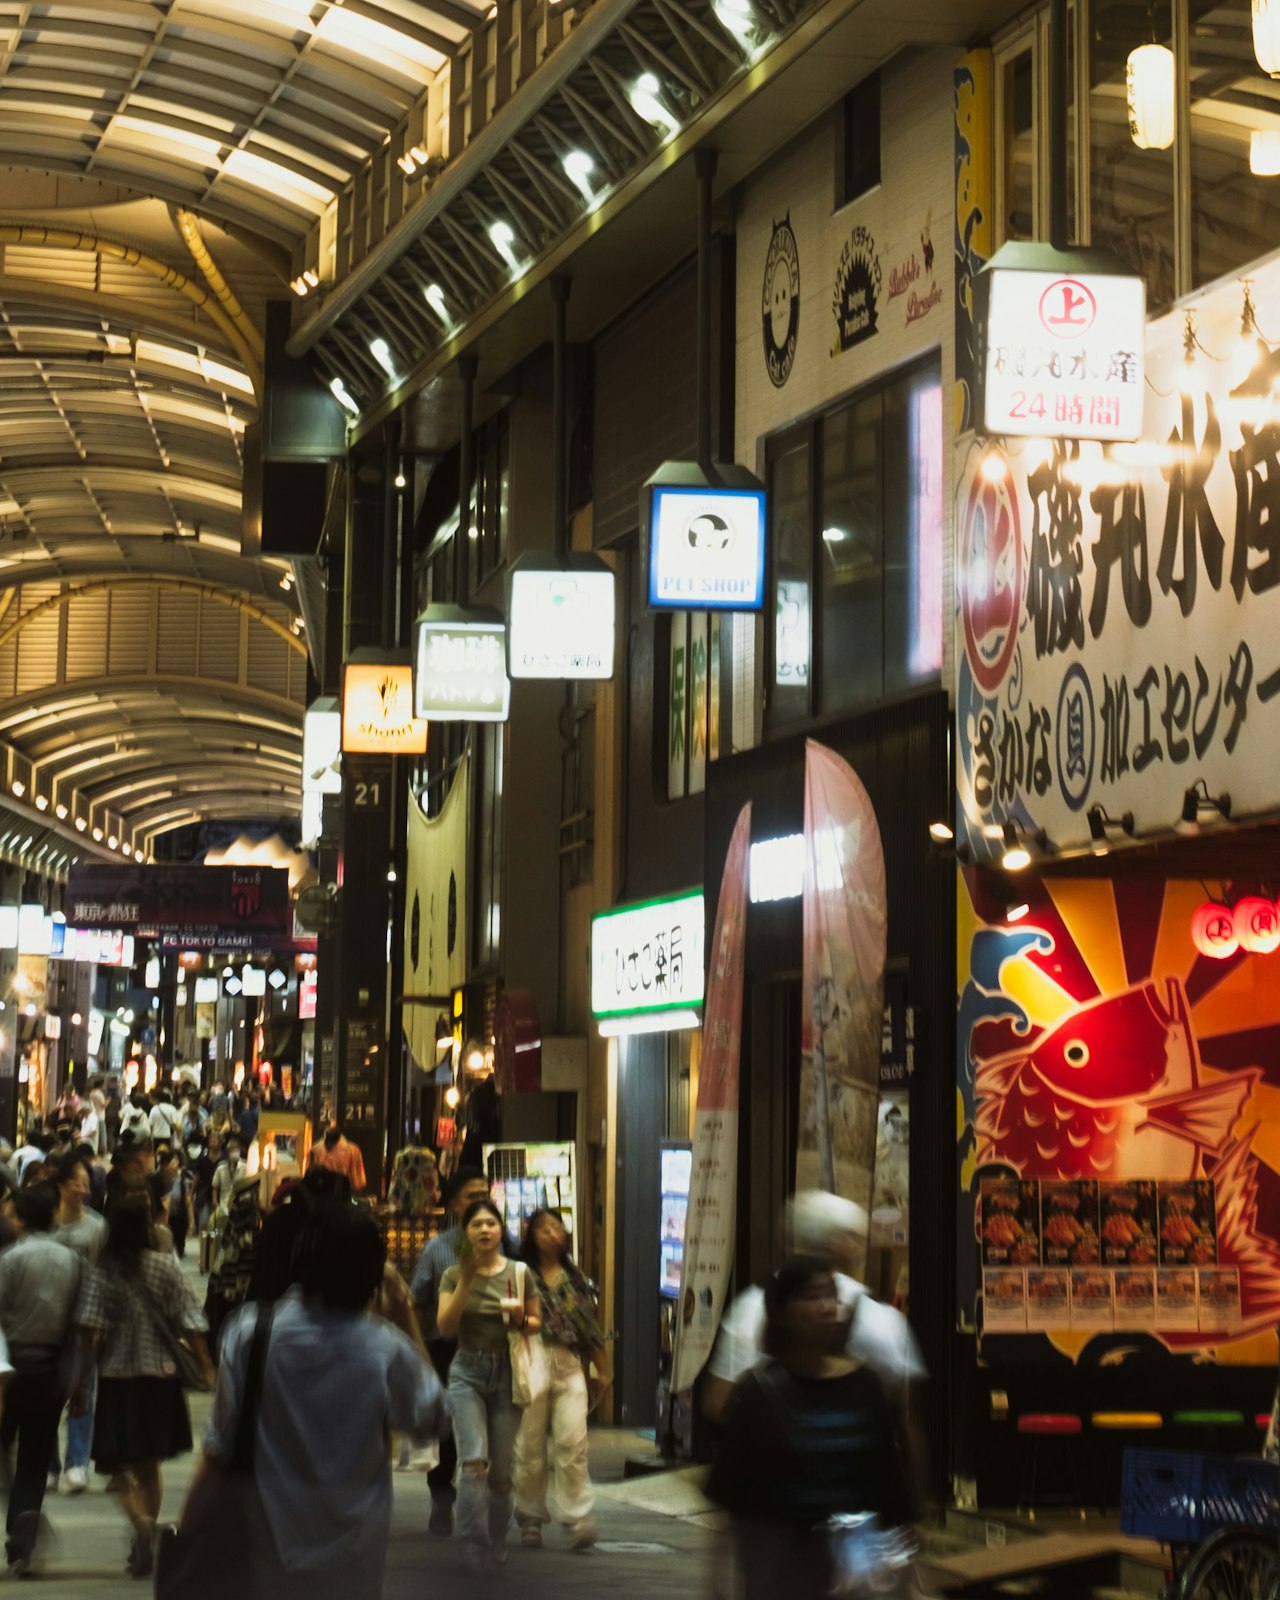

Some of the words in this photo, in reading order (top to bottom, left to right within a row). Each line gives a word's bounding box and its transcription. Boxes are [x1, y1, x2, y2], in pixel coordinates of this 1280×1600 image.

[1048, 286, 1087, 325] 上
[1008, 390, 1121, 426] 24時間
[701, 576, 751, 593] SHOP
[355, 783, 380, 806] 21
[162, 936, 178, 946] FC
[180, 936, 216, 947] TOKYO
[217, 936, 253, 947] GAME!
[615, 925, 683, 997] ひさこ薬局
